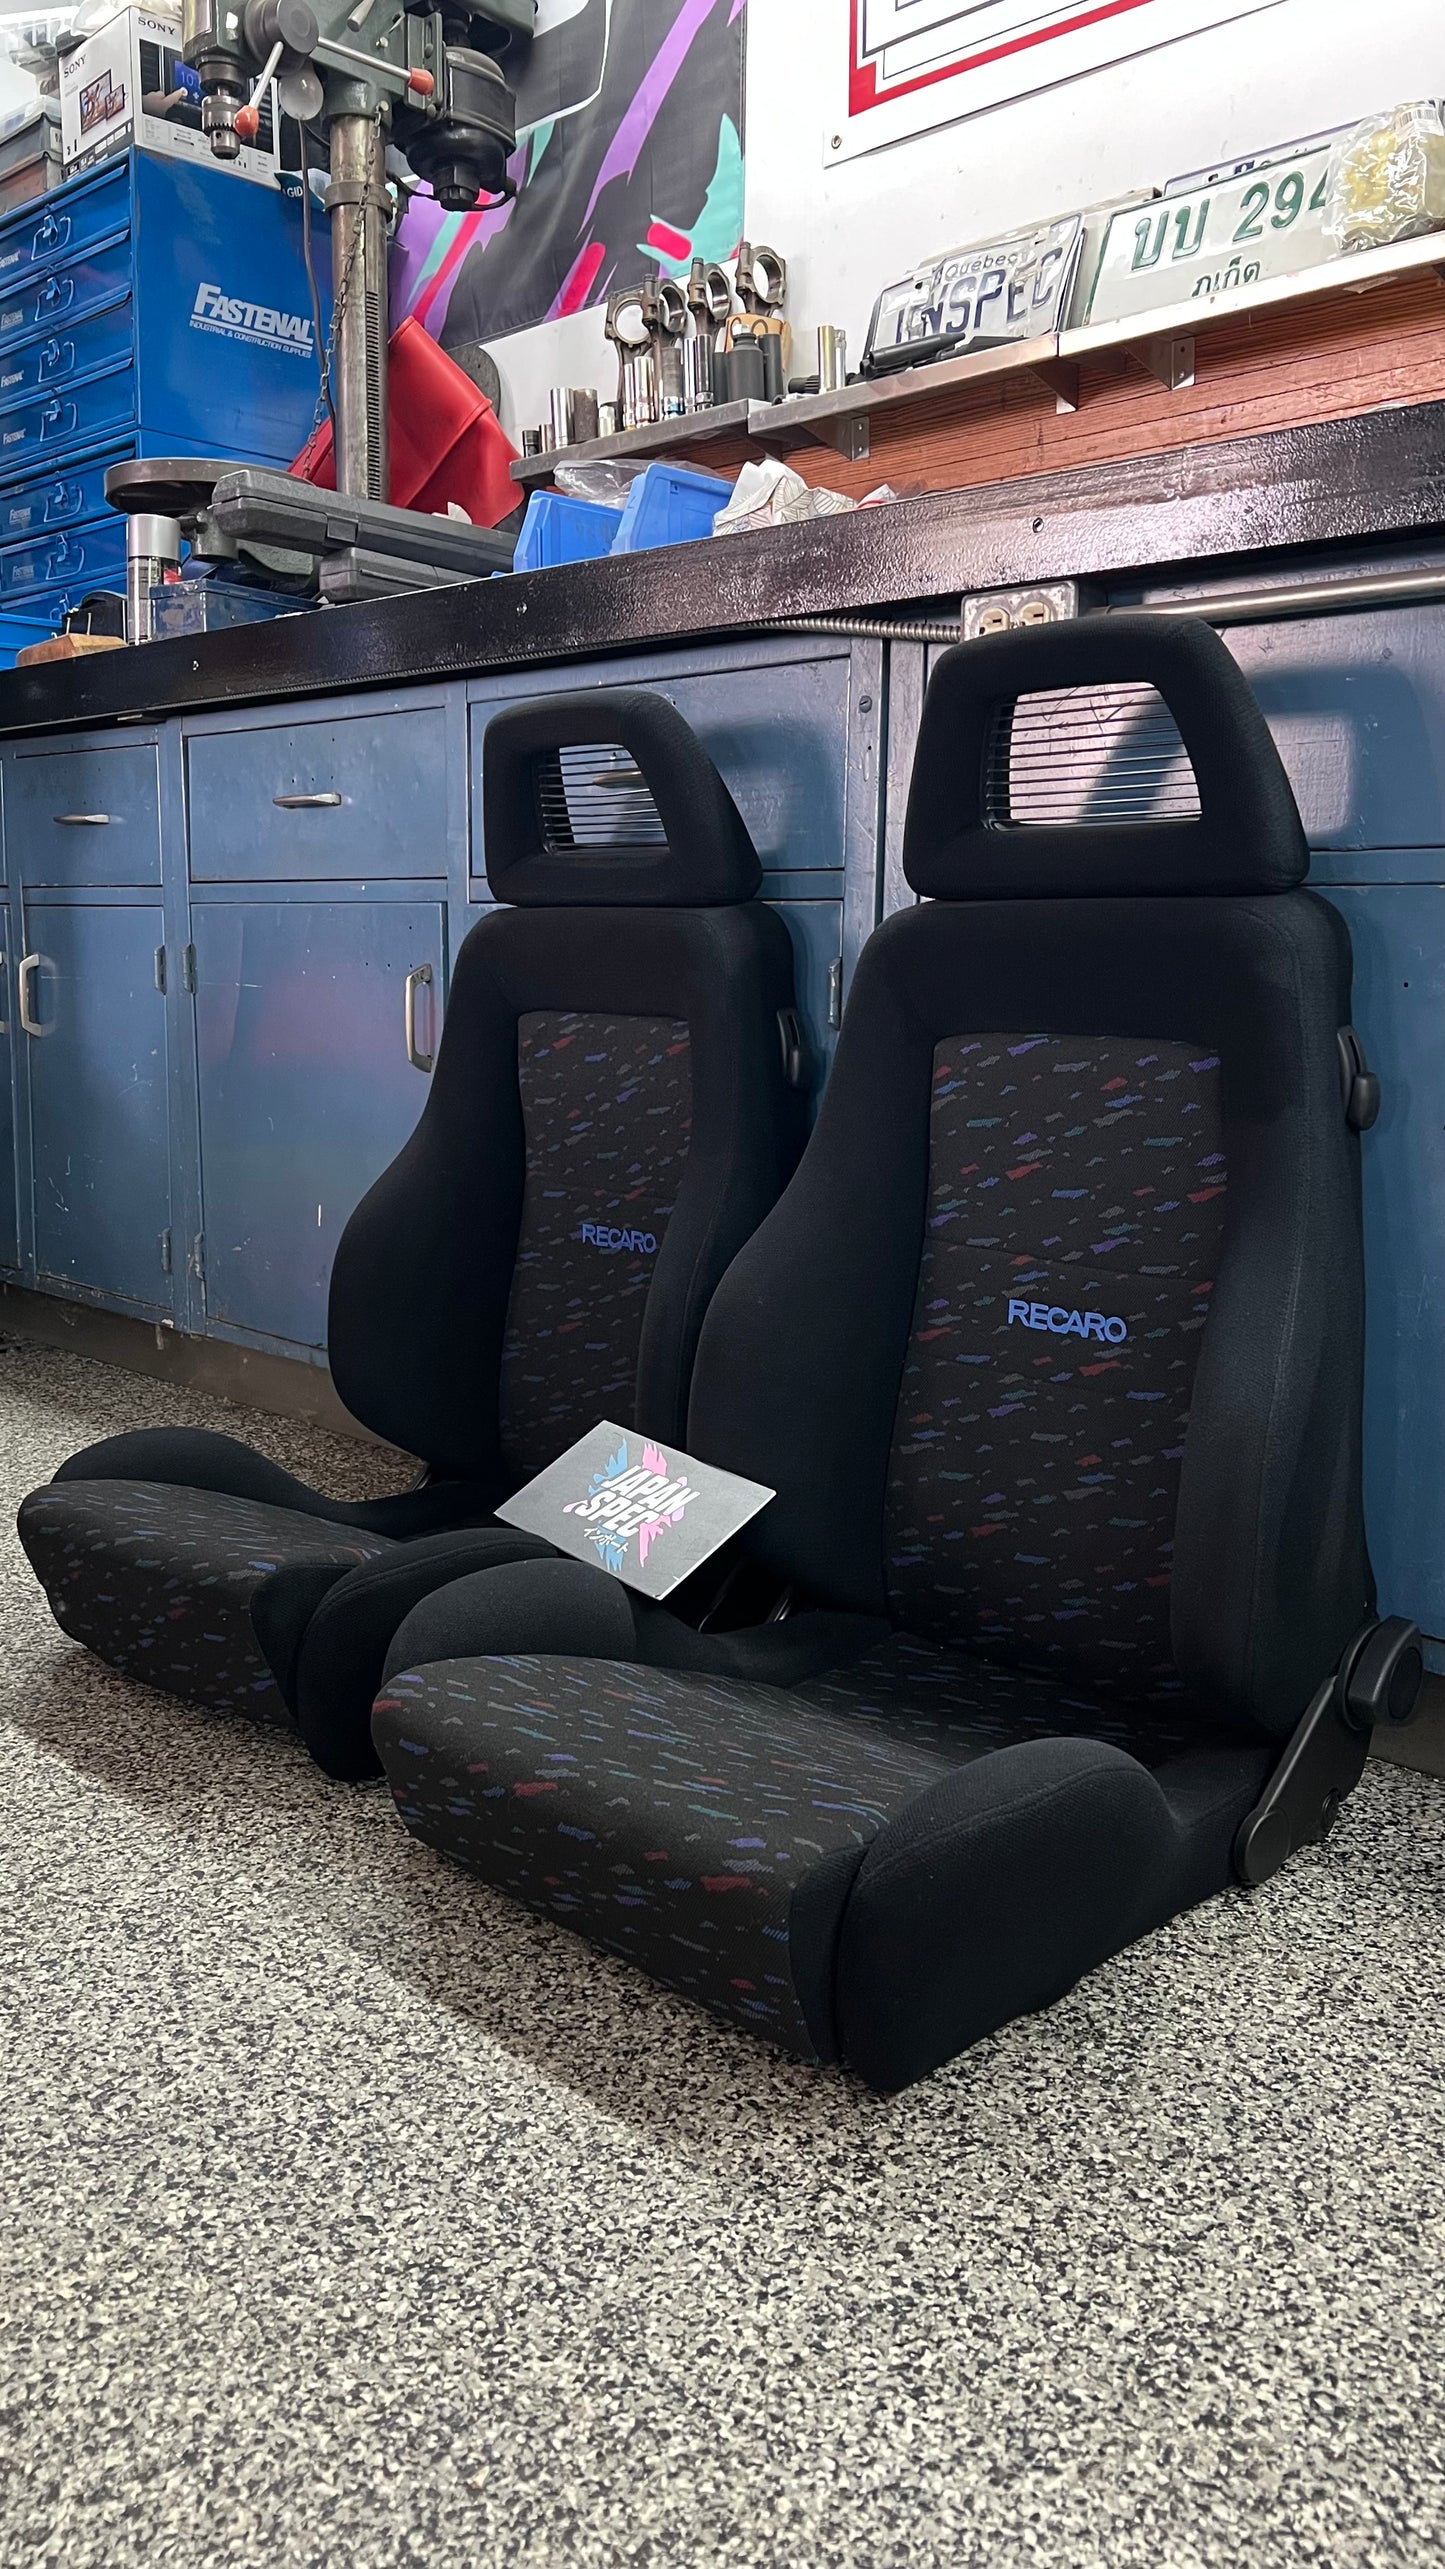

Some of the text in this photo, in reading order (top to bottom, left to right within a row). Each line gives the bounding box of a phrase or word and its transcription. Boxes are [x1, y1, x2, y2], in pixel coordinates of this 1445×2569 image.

[137, 16, 176, 36] SONY
[64, 54, 87, 79] SONY
[194, 282, 314, 345] FASTENAL
[189, 319, 227, 338] INDUSTRIAL
[234, 331, 283, 351] CONSTRUCTION
[281, 344, 312, 359] SUPPLIES
[581, 1223, 657, 1255] RECARO
[1008, 1299, 1128, 1344] RECARO
[604, 1464, 701, 1516] JAPAN
[576, 1491, 661, 1536] SPEC
[583, 1526, 630, 1555] インポート
